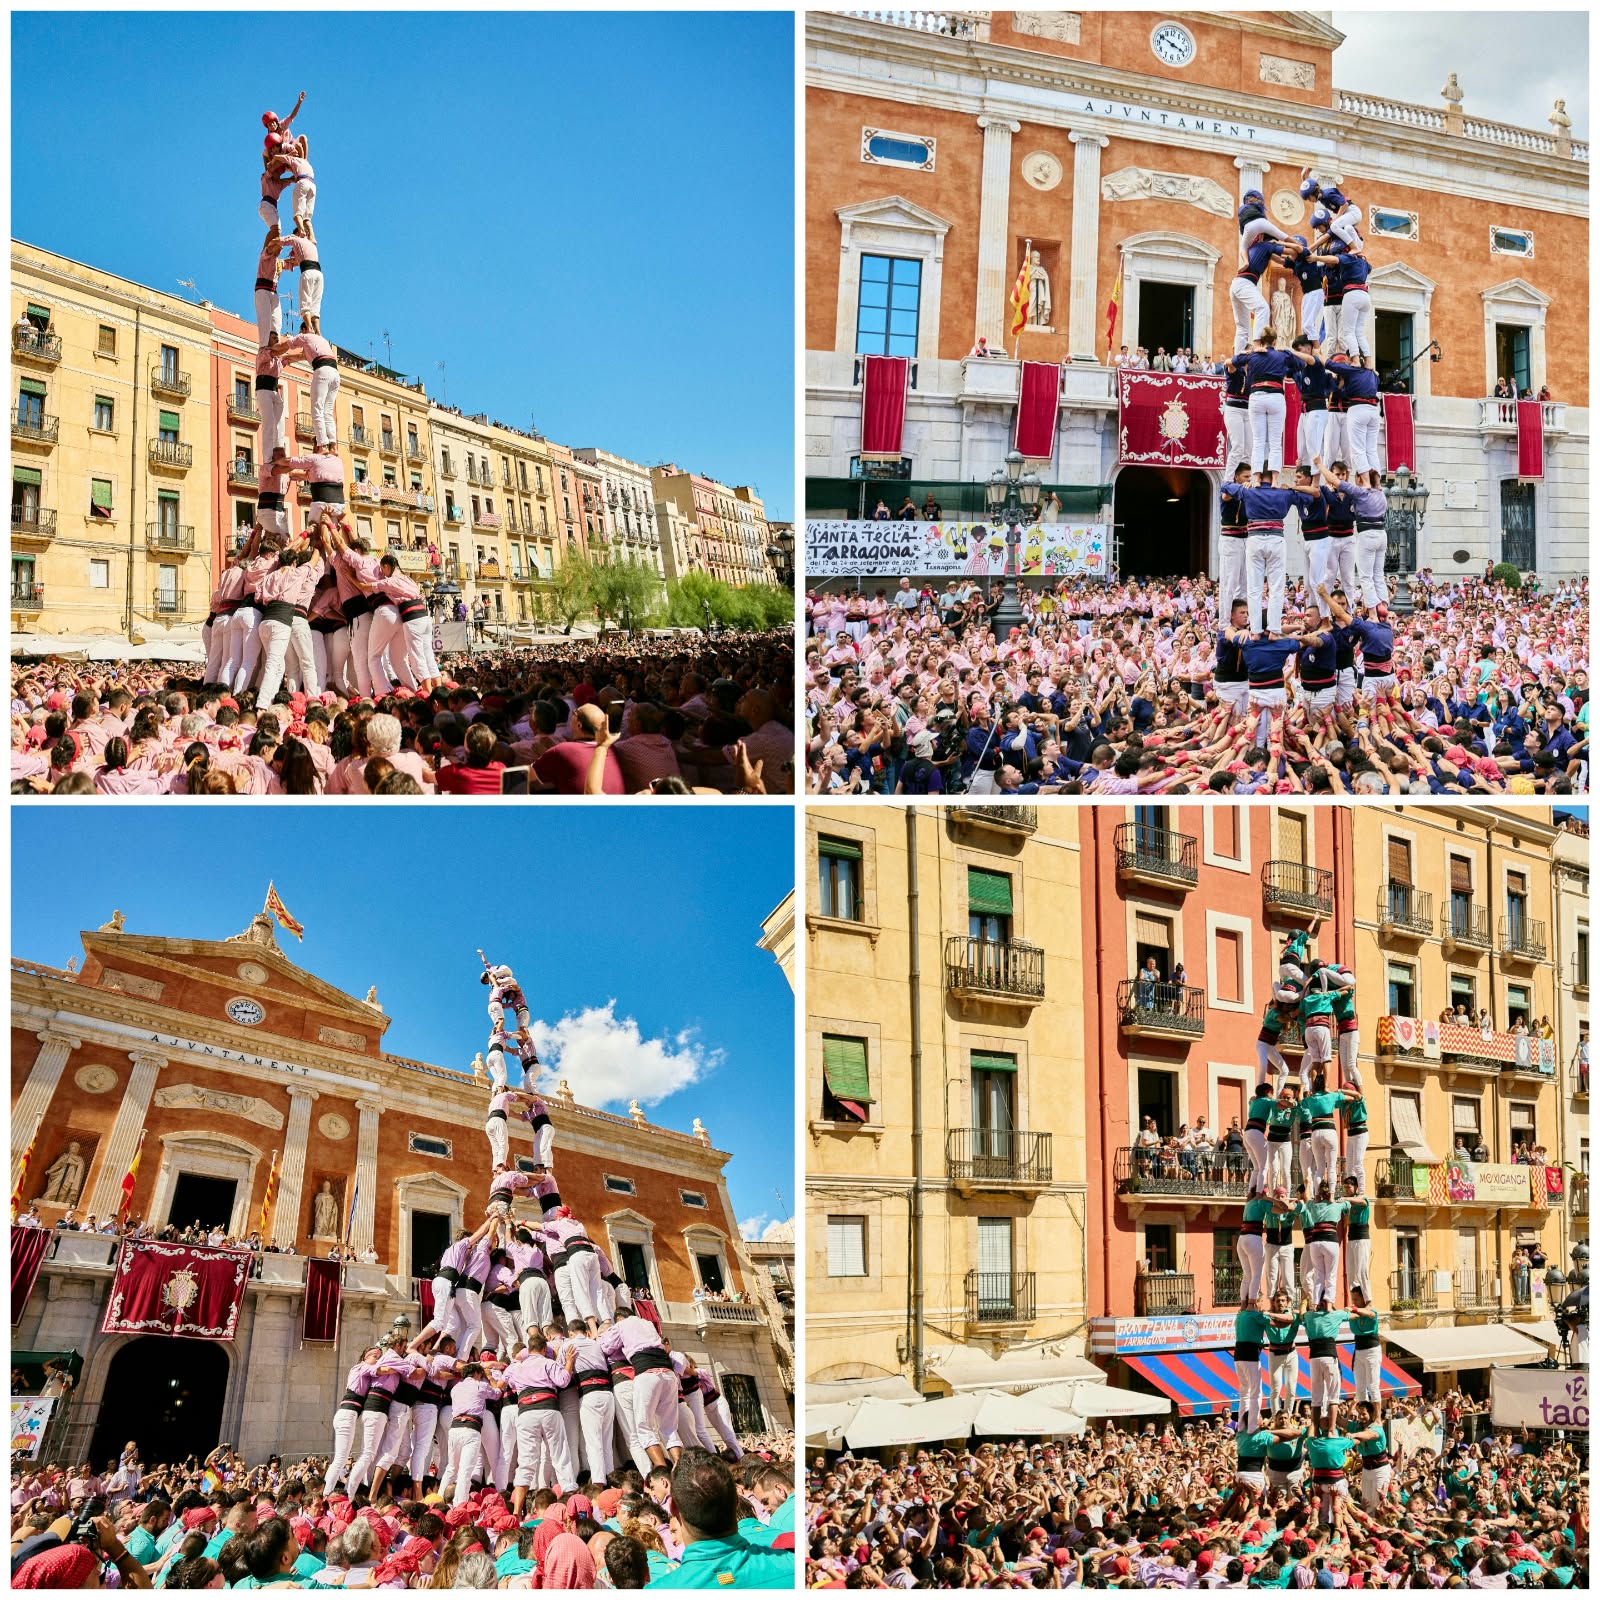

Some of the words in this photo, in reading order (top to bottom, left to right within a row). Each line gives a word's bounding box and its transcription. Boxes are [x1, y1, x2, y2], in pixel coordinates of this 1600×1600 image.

[1085, 101, 1256, 139] AJVNTAMENT
[810, 528, 858, 544] SANTA
[151, 1034, 309, 1076] AJVNTAMENT
[1116, 1322, 1142, 1336] GRAN
[1124, 1336, 1167, 1346] TARRAGONA
[1539, 1396, 1589, 1427] tac
